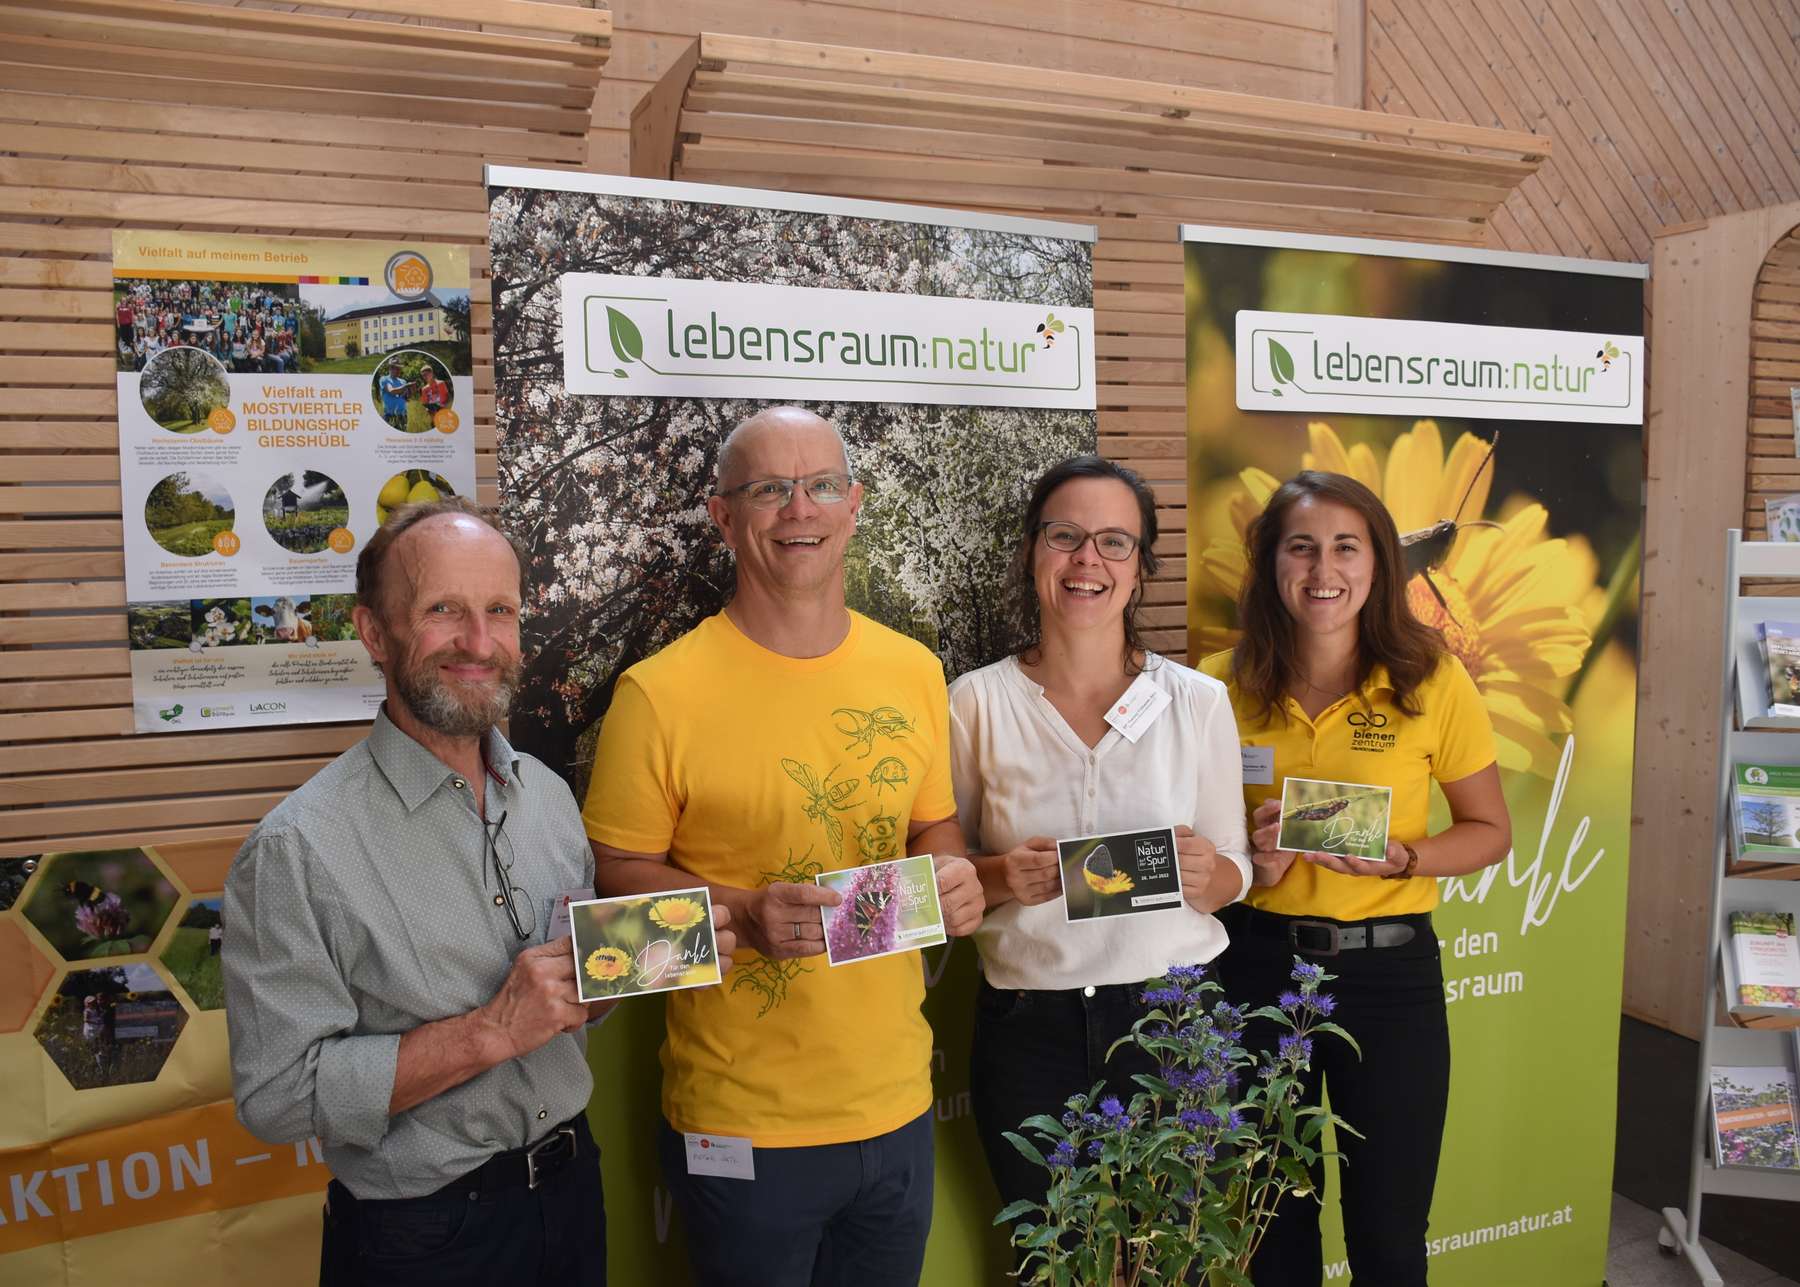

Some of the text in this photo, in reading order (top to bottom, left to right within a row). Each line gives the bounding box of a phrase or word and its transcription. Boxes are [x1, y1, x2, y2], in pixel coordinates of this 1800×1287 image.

[138, 246, 309, 263] Vielfalt auf meinem Betrieb
[667, 308, 1036, 373] lebensraum:natur
[1313, 339, 1595, 393] lebensraum:natur
[262, 386, 343, 399] Vielfalt am
[243, 402, 363, 415] MOSTVIERTLER
[247, 419, 360, 432] BILDUNGSHOF
[258, 432, 350, 448] GIESSHÜBL
[249, 702, 287, 712] LACON
[1353, 729, 1395, 742] bienen
[1351, 739, 1395, 749] zentrum
[1137, 844, 1166, 856] Natur
[1146, 856, 1167, 873] Spur
[900, 881, 927, 896] Natur
[909, 894, 927, 912] Spur
[1454, 927, 1498, 958] den
[635, 932, 710, 987] Danke
